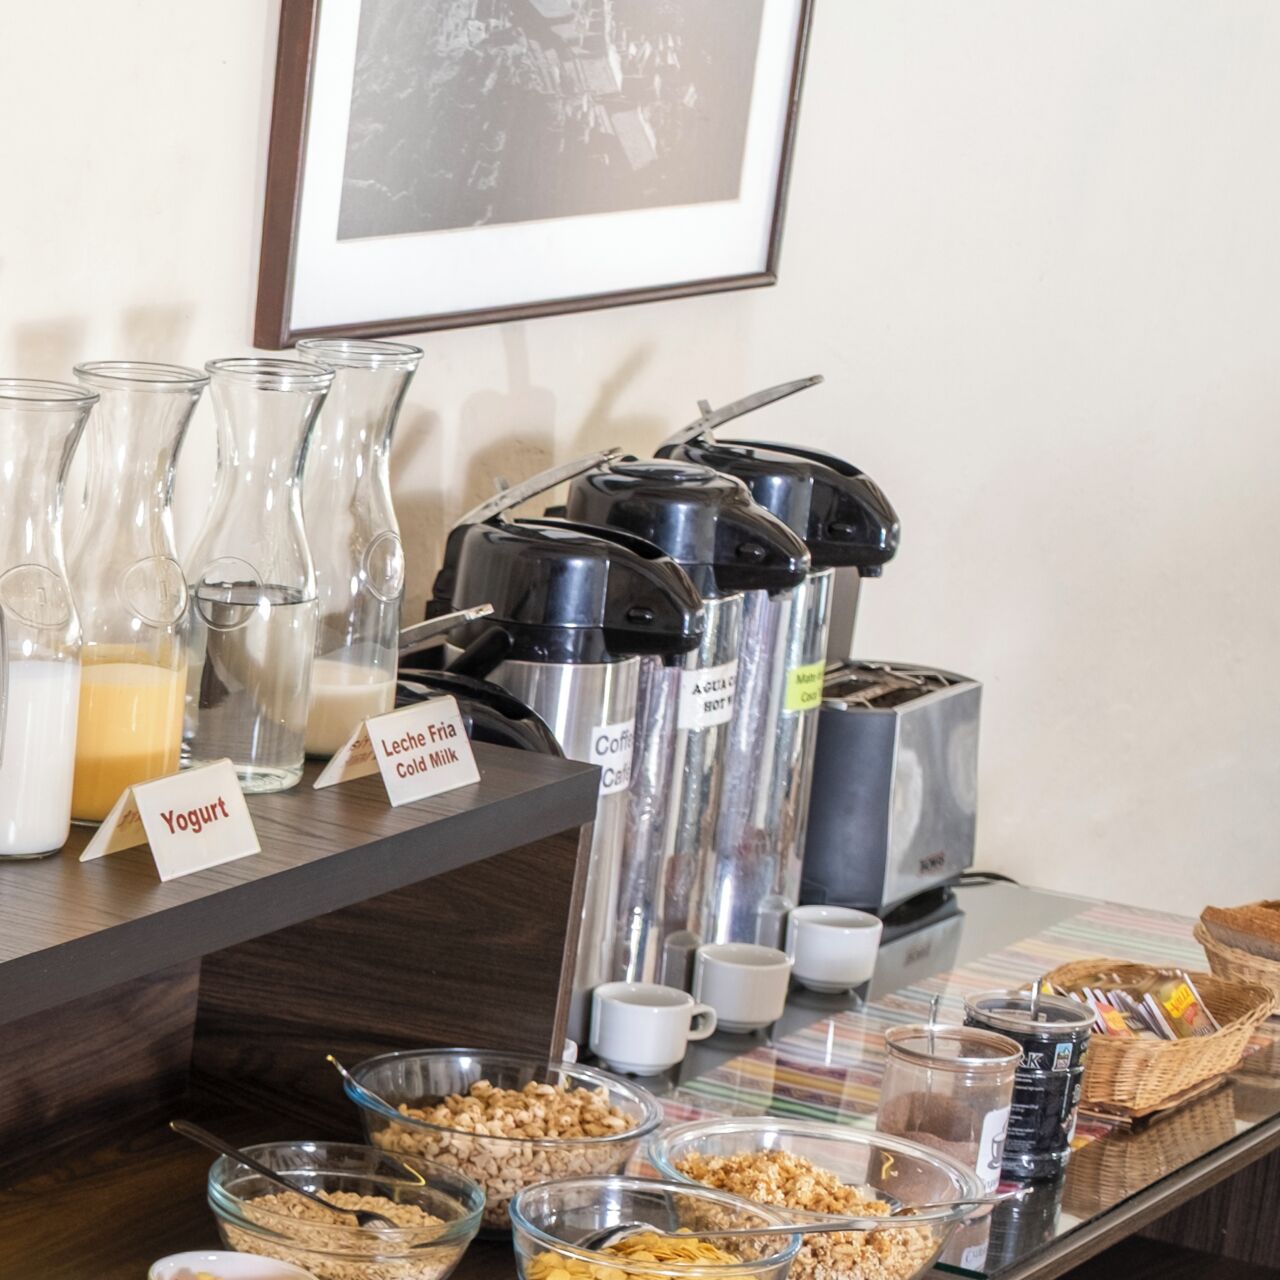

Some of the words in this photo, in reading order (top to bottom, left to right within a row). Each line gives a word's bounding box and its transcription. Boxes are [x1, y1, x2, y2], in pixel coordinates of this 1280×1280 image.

[704, 698, 726, 712] HOT
[381, 731, 426, 757] Leche
[427, 721, 458, 744] Fria
[395, 754, 429, 779] Cold
[429, 747, 459, 770] Milk
[160, 795, 230, 836] Yogurt
